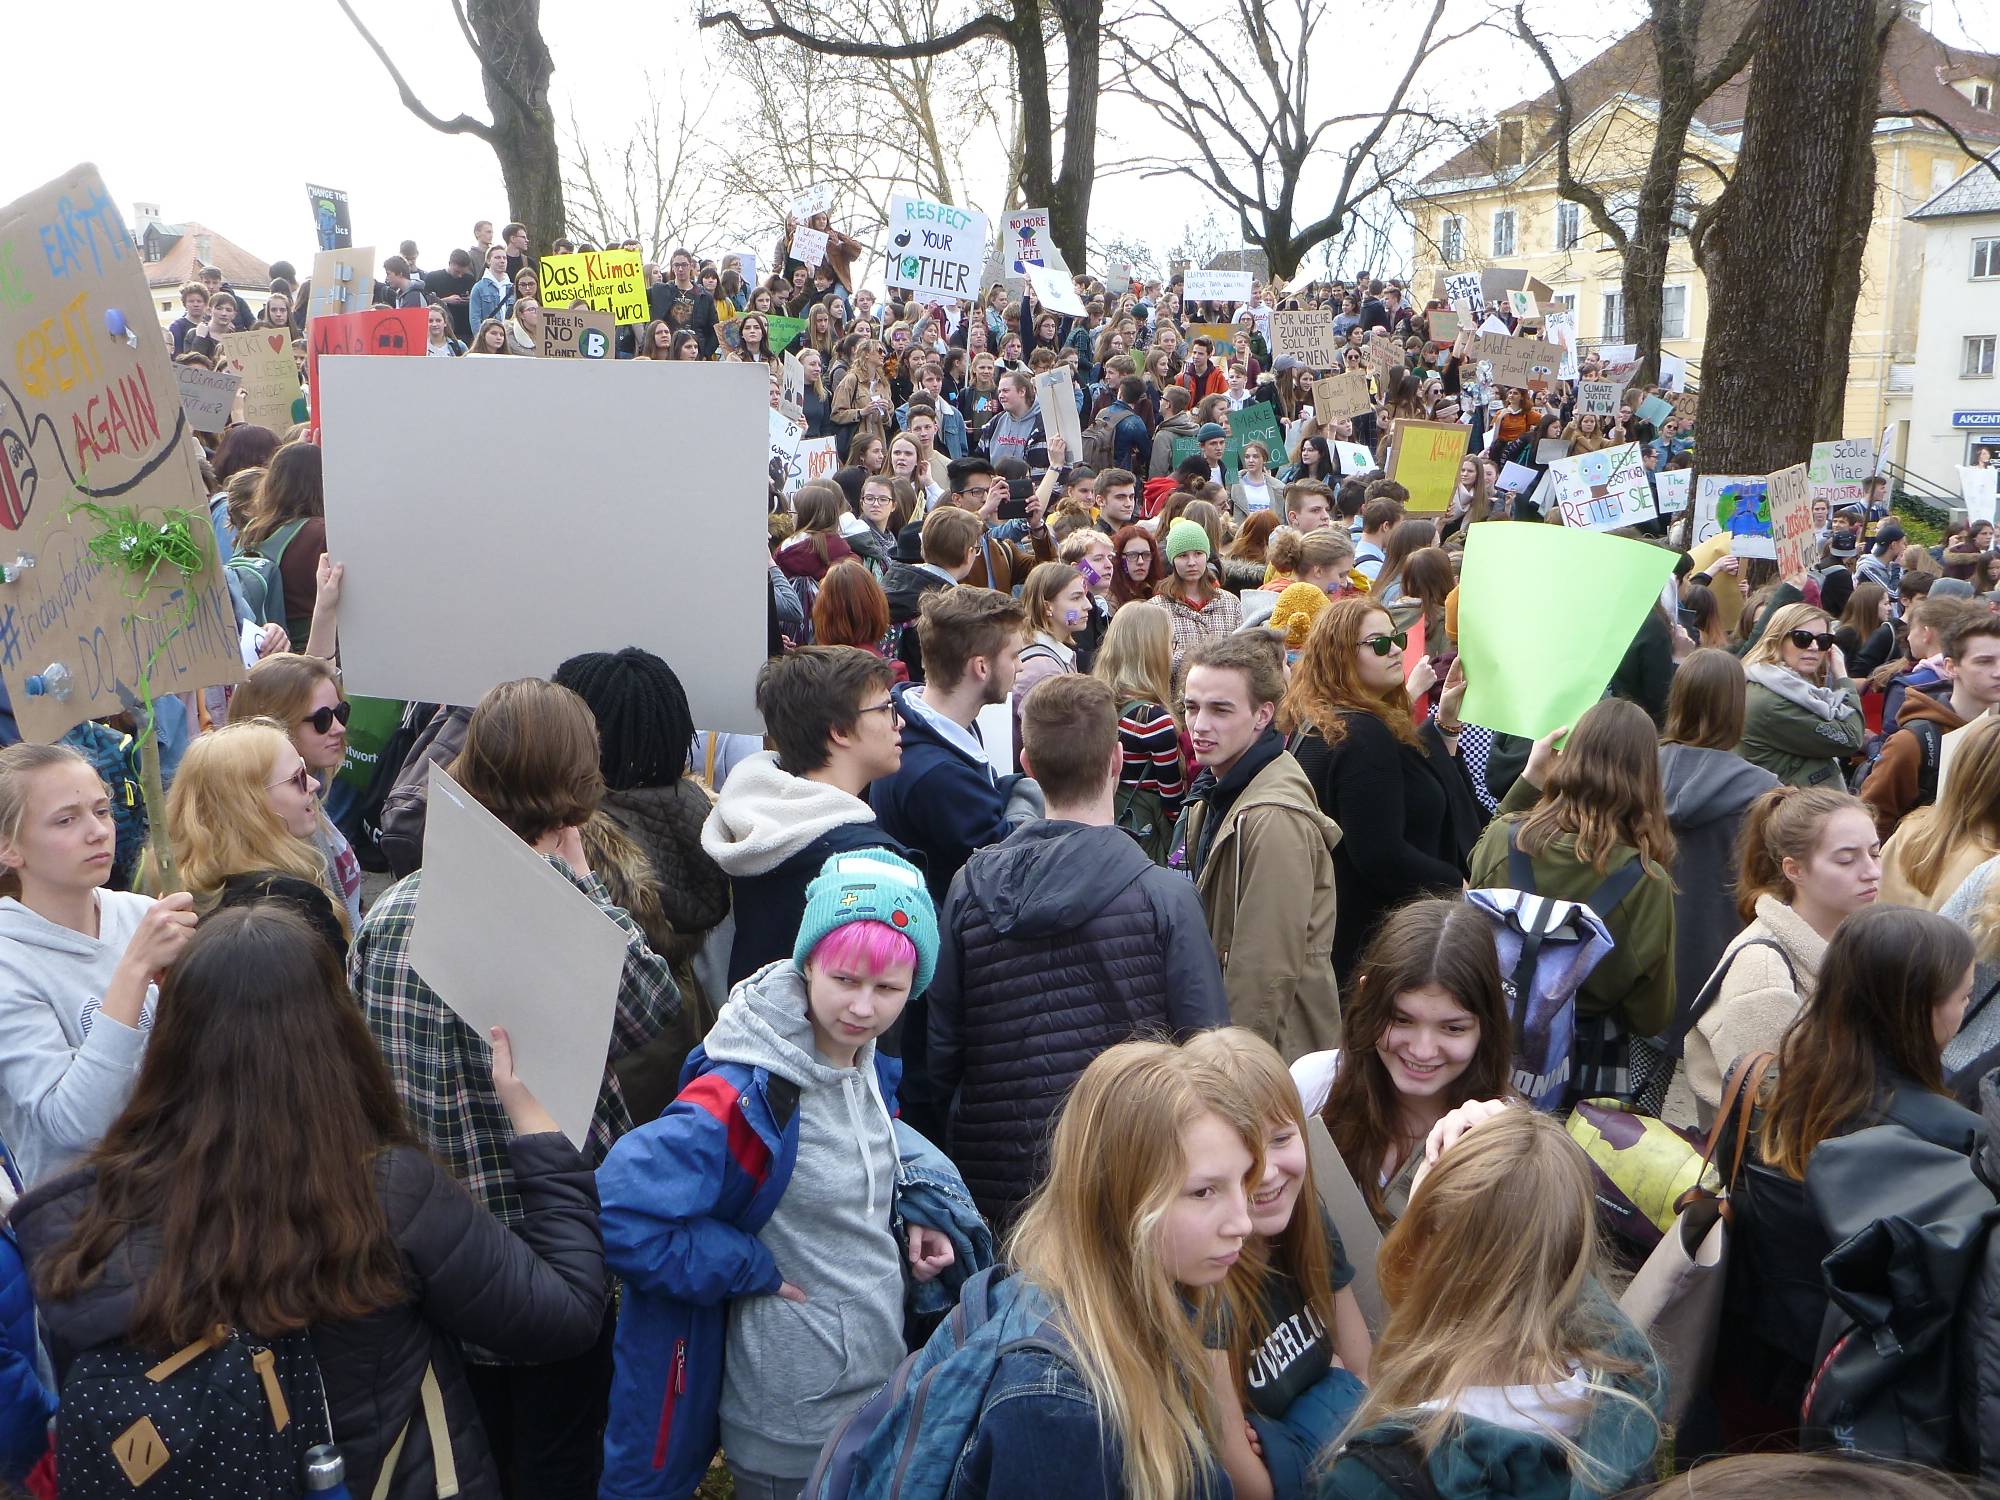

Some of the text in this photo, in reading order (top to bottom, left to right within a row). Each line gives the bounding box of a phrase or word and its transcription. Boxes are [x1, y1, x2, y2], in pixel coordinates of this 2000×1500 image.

[906, 202, 972, 230] RESPECT
[1010, 217, 1047, 229] NO MORE
[922, 229, 953, 251] YOUR
[1016, 239, 1037, 248] TIME
[1017, 249, 1040, 260] LEFT
[540, 254, 640, 289] Das Klima:
[617, 281, 634, 294] als
[543, 313, 584, 328] THERE IS
[1274, 313, 1294, 325] FÜR
[1298, 313, 1331, 325] WELCHE
[545, 327, 573, 342] NO
[1280, 326, 1326, 339] ZUKUNFT
[544, 333, 605, 358] PLANET B
[1282, 338, 1320, 350] SOLL ICH
[1290, 350, 1330, 367] ERNEN
[1583, 384, 1613, 393] CLIMATE
[1587, 401, 1615, 413] NOW
[73, 362, 161, 475] AGAIN
[1234, 410, 1272, 428] MAKE
[1959, 414, 2000, 424] AKZENT
[785, 422, 798, 437] is
[808, 450, 838, 479] HOT
[1611, 450, 1638, 469] ERDE
[1553, 470, 1568, 484] Die
[1831, 463, 1863, 479] Vitae
[1664, 474, 1685, 485] The
[1561, 486, 1653, 527] RETTET SIE
[79, 626, 116, 701] DO
